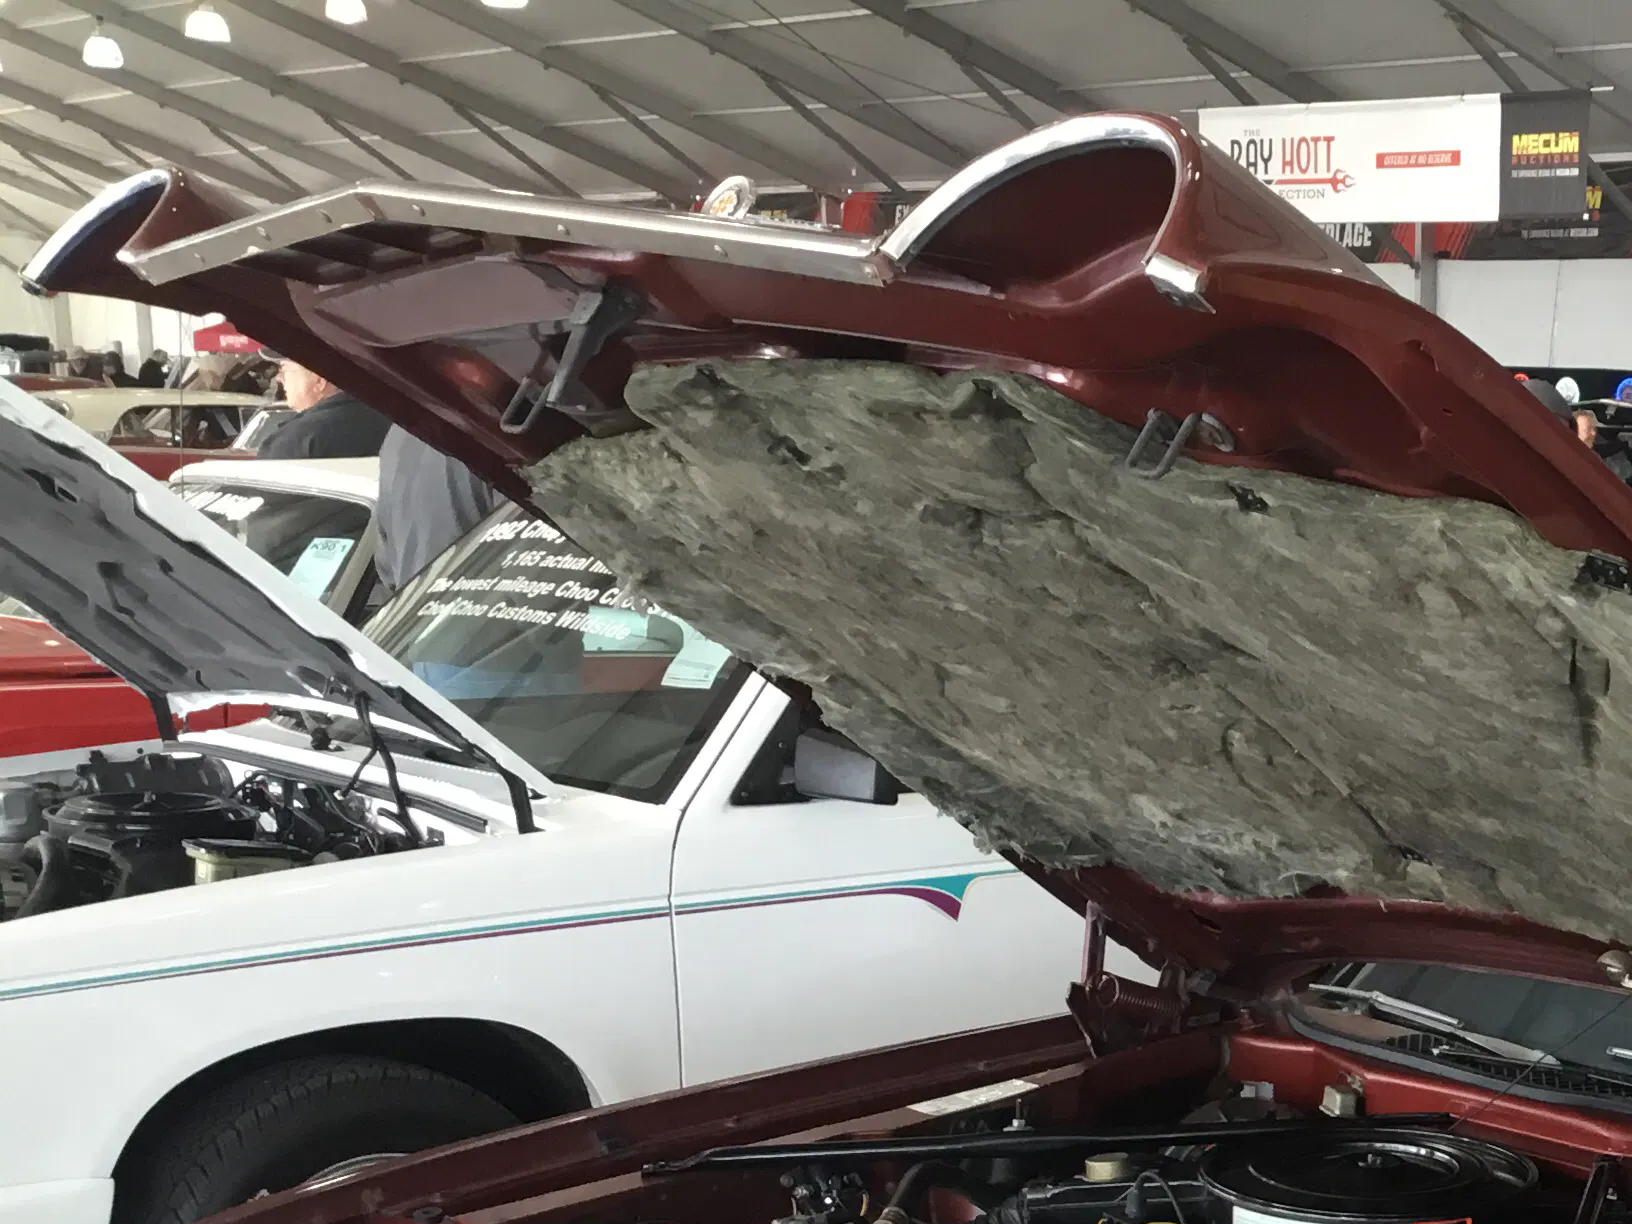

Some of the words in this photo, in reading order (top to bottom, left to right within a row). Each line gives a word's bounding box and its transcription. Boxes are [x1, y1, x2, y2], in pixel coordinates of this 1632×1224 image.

[1281, 136, 1335, 174] HOTT
[1511, 132, 1580, 156] MECUM
[538, 553, 595, 572] actual
[493, 575, 556, 598] mileage
[554, 580, 600, 602] Choo
[487, 601, 557, 625] Customs
[554, 609, 632, 641] Wildside
